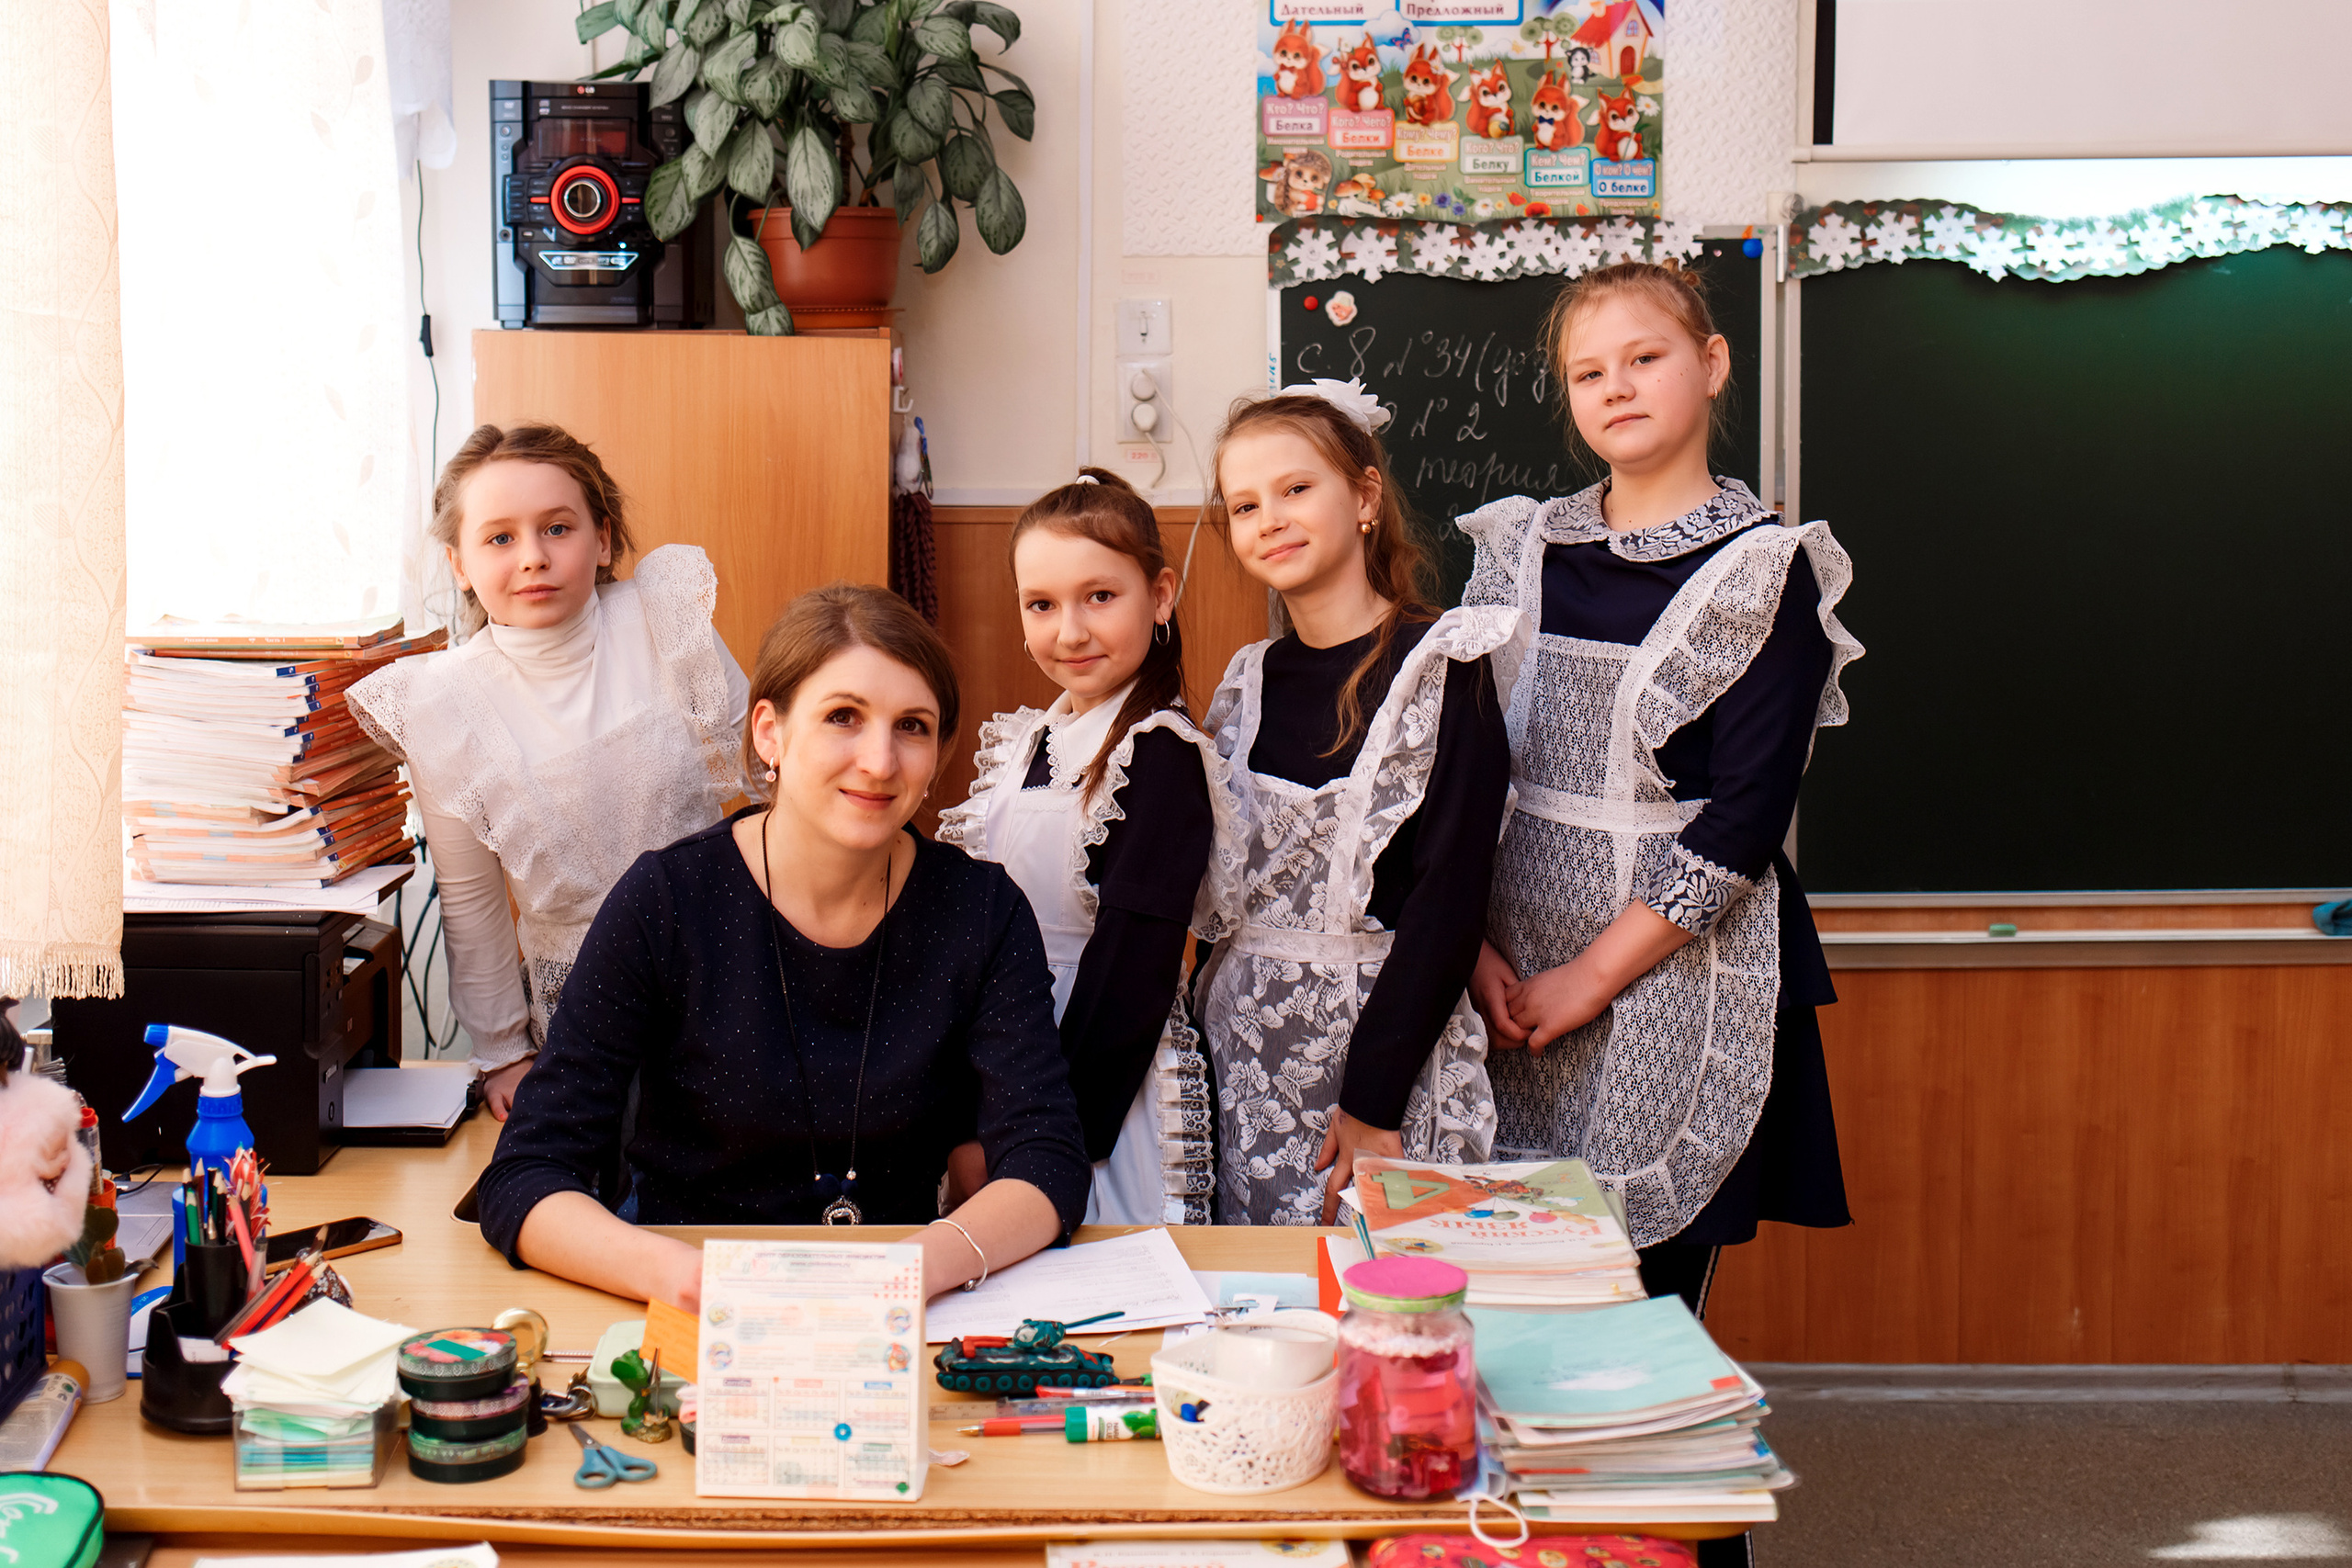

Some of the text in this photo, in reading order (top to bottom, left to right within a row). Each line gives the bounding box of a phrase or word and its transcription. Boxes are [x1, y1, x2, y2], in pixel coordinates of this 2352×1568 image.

[1281, 4, 1364, 16] Дательный
[1407, 3, 1504, 17] Предложный
[1266, 103, 1325, 115] Кто? Что?
[1276, 120, 1313, 131] Белка
[1332, 116, 1360, 128] Кого?
[1342, 132, 1380, 143] Белки
[1407, 145, 1444, 156] Белке
[1465, 141, 1520, 154] Кого? Что?
[1473, 159, 1509, 172] Белку
[1531, 154, 1586, 166] Кем? Чем?
[1535, 172, 1579, 182] Белкой
[1599, 182, 1647, 193] О белке
[1348, 326, 1376, 378] 8
[1456, 401, 1488, 443] 2
[1415, 451, 1572, 506] теория
[1372, 1170, 1450, 1210] 4
